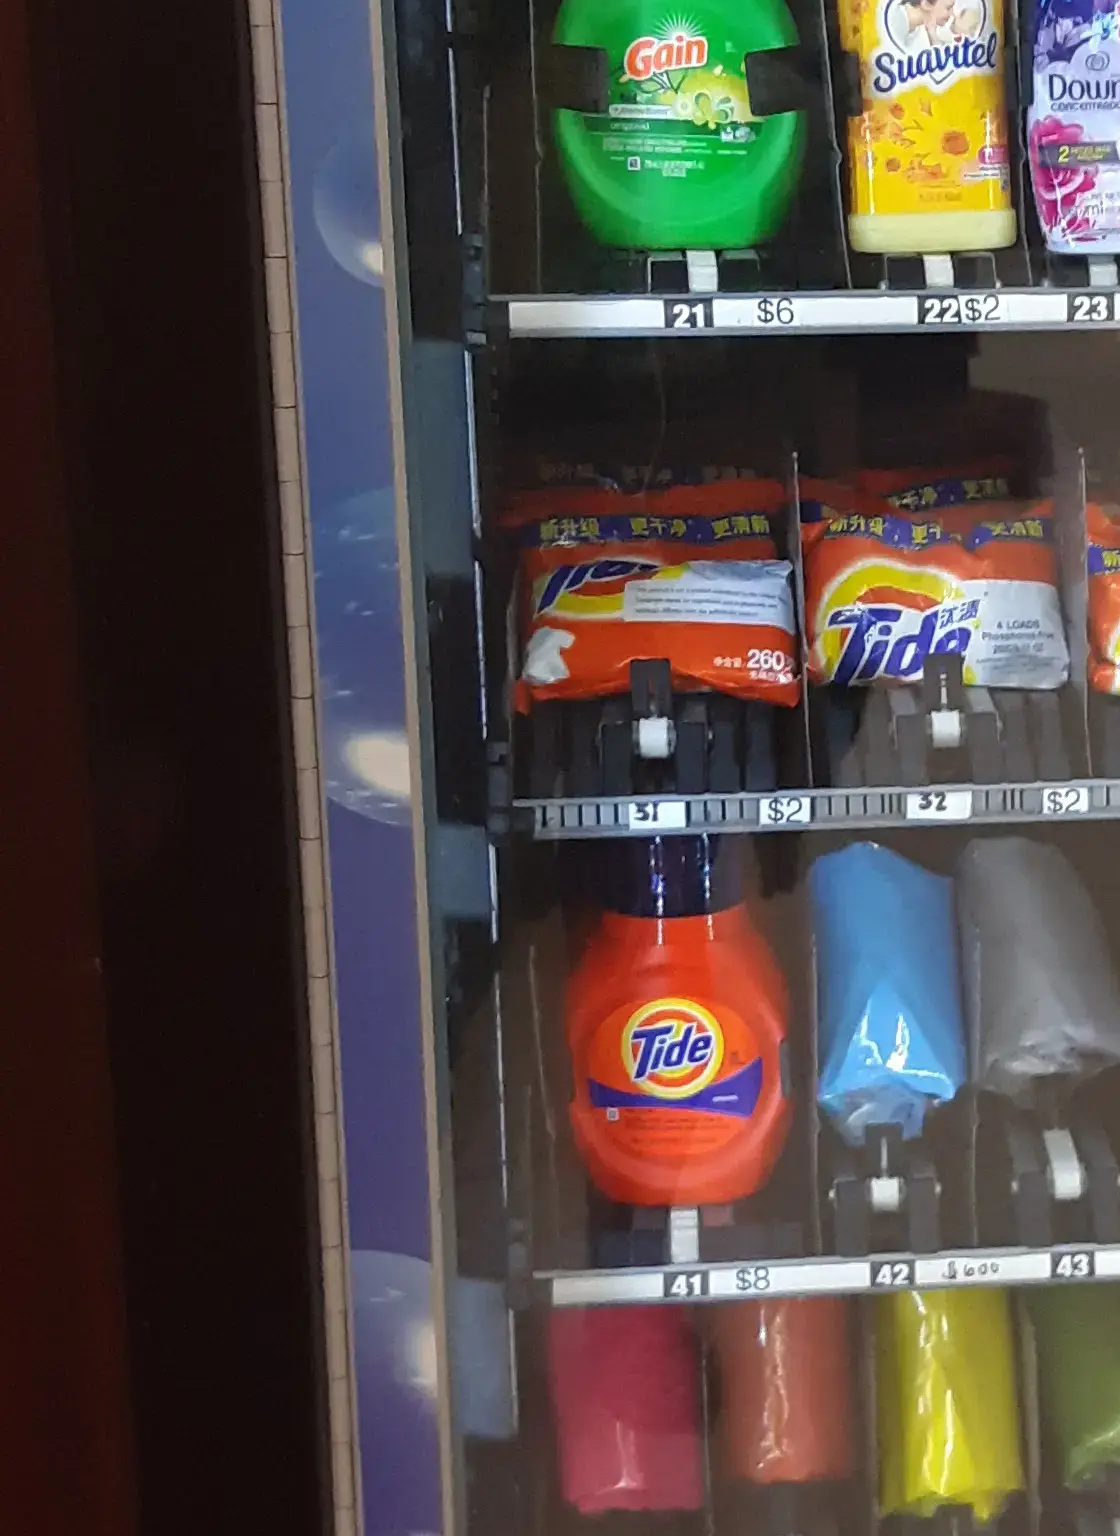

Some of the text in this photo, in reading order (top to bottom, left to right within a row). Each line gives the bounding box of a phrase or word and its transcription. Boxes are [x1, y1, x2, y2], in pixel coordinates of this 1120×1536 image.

[626, 35, 707, 77] Gain
[873, 30, 997, 93] Suavitel
[672, 305, 706, 328] 21
[757, 297, 794, 324] $6
[923, 303, 959, 324] 22
[964, 296, 1001, 322] $2
[1073, 296, 1108, 321] 23
[747, 649, 785, 671] 260
[827, 602, 974, 686] Tide
[633, 802, 660, 822] 31
[767, 796, 803, 822] $2
[918, 792, 948, 811] 32
[1047, 787, 1081, 812] $2
[631, 1024, 713, 1079] Tide
[670, 1274, 701, 1296] 41
[735, 1267, 770, 1291] $8
[875, 1264, 911, 1286] 42
[1056, 1253, 1090, 1276] 43
